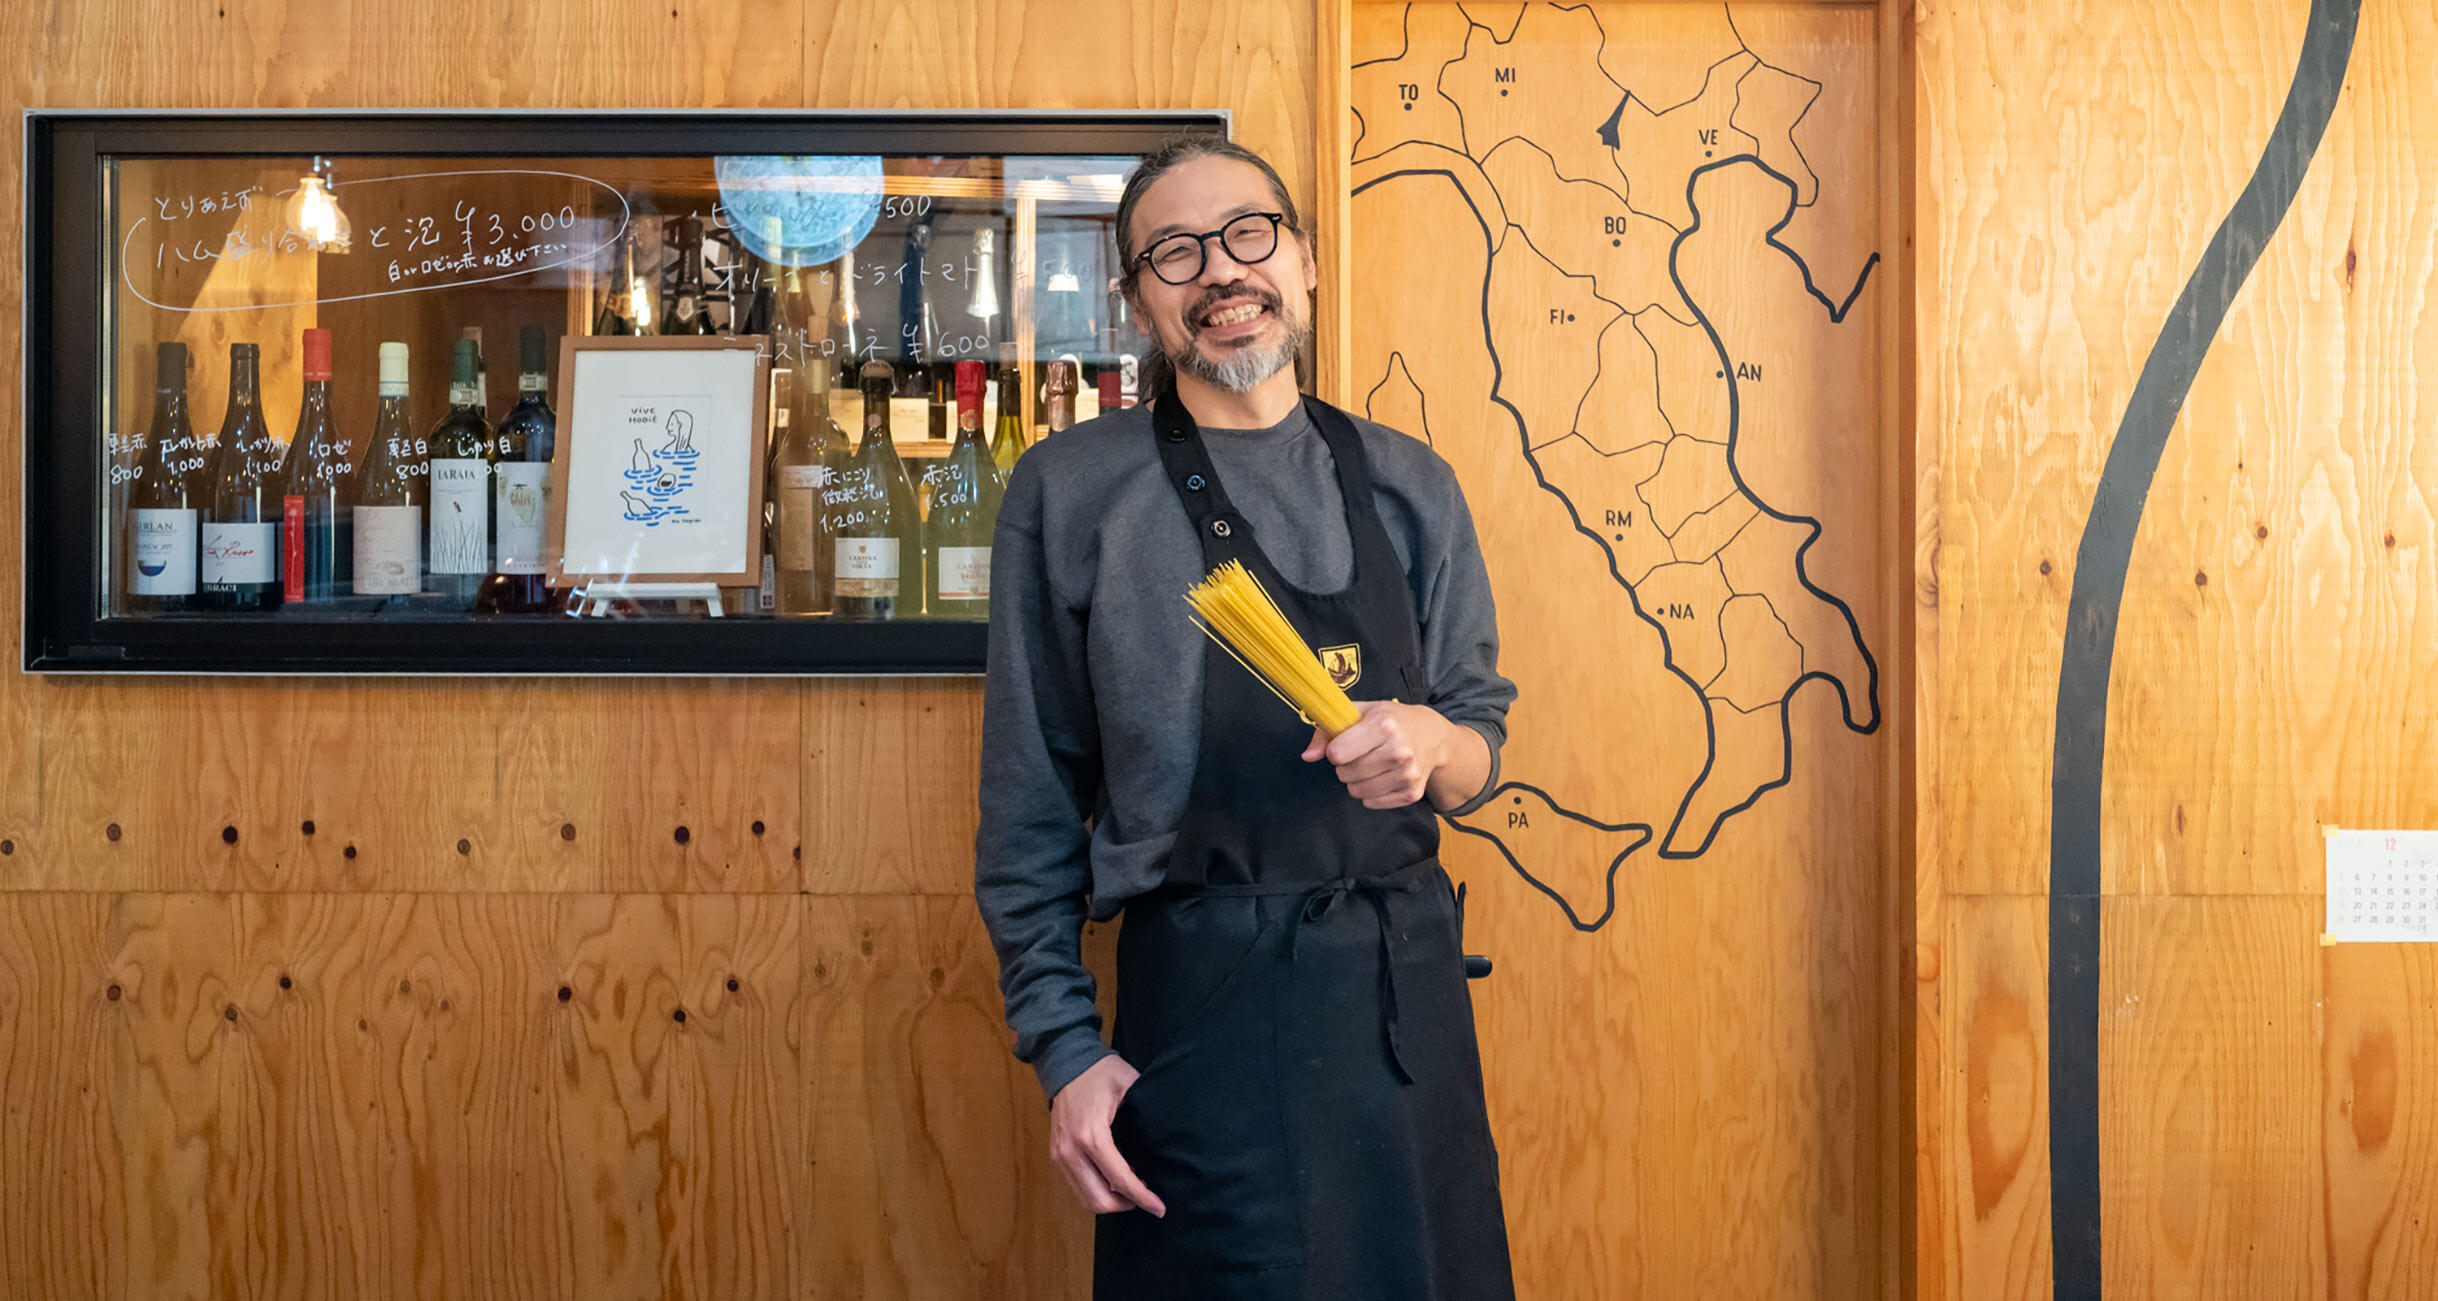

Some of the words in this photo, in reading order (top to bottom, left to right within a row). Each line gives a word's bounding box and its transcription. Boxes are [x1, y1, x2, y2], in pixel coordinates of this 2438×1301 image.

[1495, 67, 1516, 83] MI
[1398, 83, 1419, 101] TO
[1698, 128, 1719, 146] VE
[1604, 216, 1627, 235] BO
[1550, 308, 1565, 325] FI
[1736, 361, 1762, 382] AN
[110, 464, 143, 485] 800
[396, 461, 429, 480] 800
[1605, 509, 1632, 528] RM
[1669, 603, 1695, 620] NA
[1508, 811, 1529, 829] PA
[2384, 837, 2397, 852] 12
